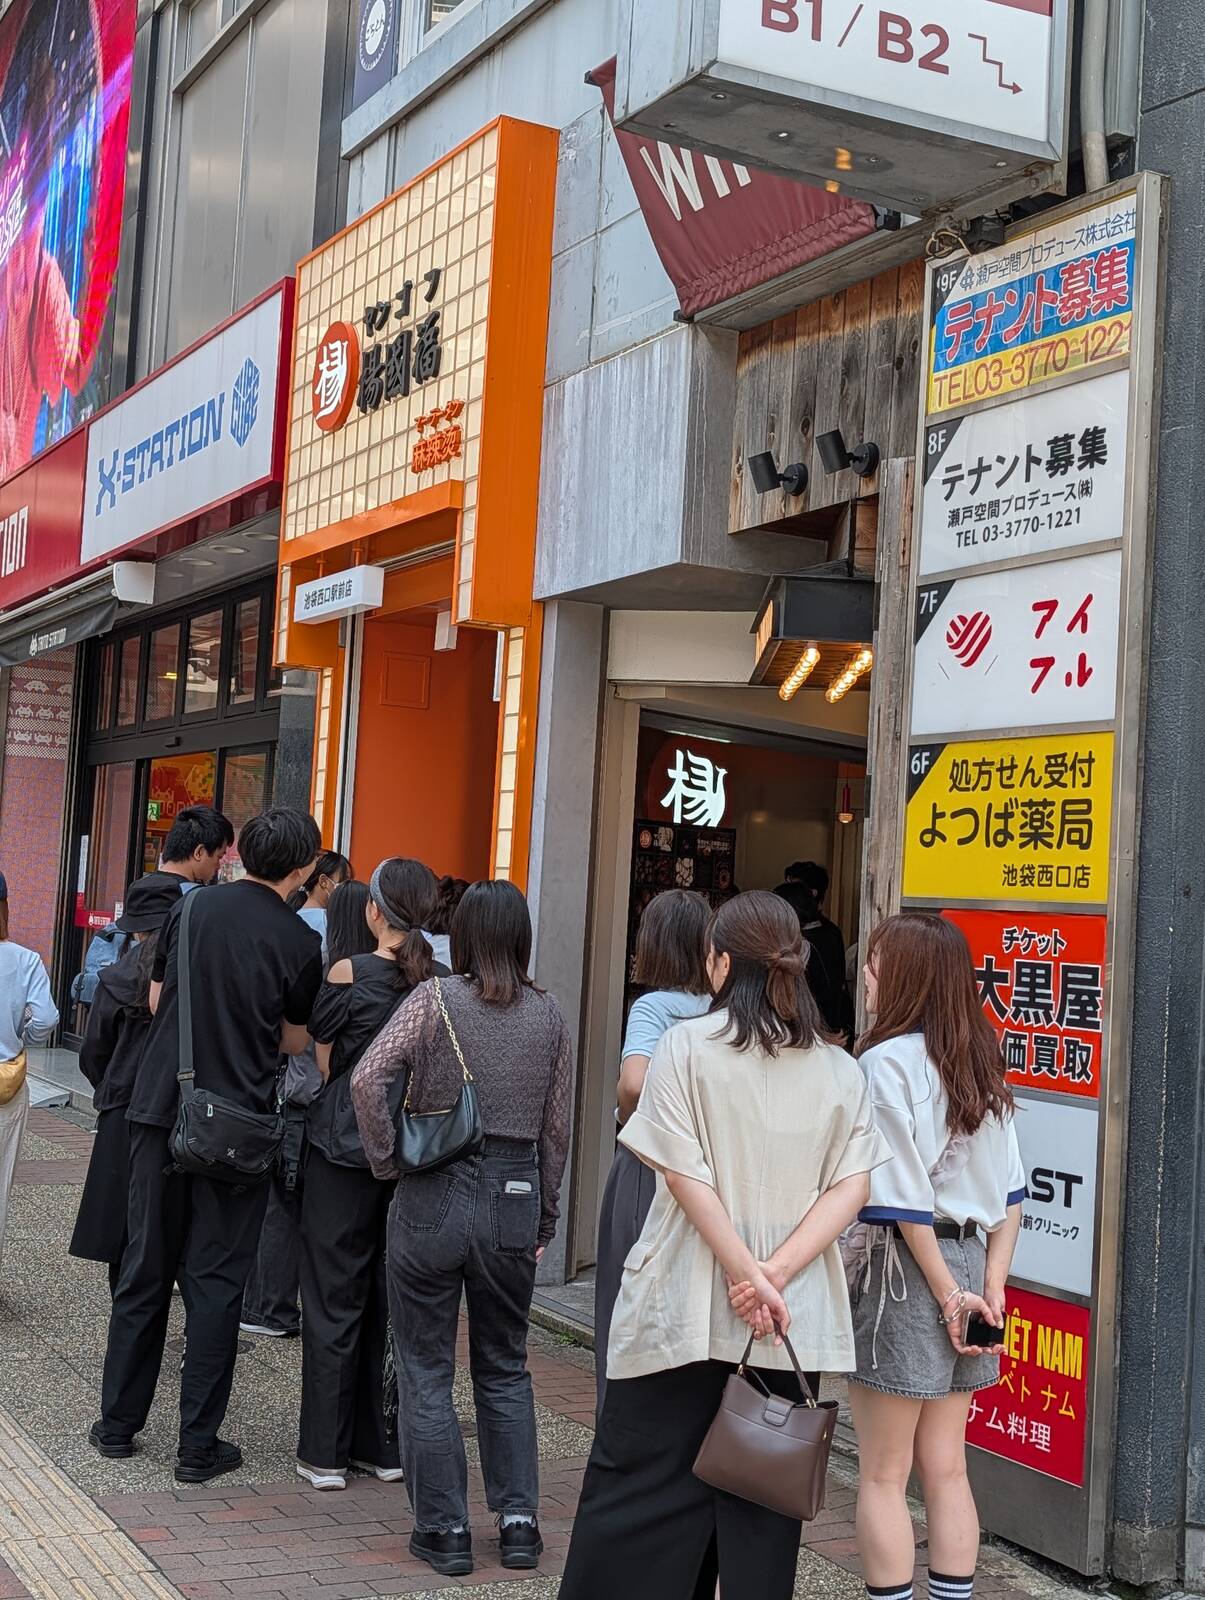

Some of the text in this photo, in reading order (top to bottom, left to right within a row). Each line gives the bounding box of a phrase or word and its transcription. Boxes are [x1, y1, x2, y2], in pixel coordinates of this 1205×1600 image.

[877, 10, 950, 75] B2
[944, 246, 1130, 363] テナント募集
[928, 429, 947, 455] 8F
[942, 425, 1108, 502] テナント募集
[956, 507, 1081, 548] TEL 03-3770-1221
[304, 579, 353, 610] 池袋西口駅前店
[920, 590, 938, 614] 7F
[1032, 593, 1093, 639] アイ
[1029, 653, 1093, 694] フル
[911, 751, 930, 774] 6F
[949, 750, 1095, 793] 処方せん受付
[919, 797, 1093, 850] よつば薬局
[1002, 864, 1091, 888] 池袋西口店
[1002, 926, 1067, 957] チケット
[974, 955, 1103, 1032] 大黒屋
[1024, 1167, 1083, 1209] ST
[1036, 1324, 1083, 1380] NAM
[968, 1399, 1051, 1453] ナム料理
